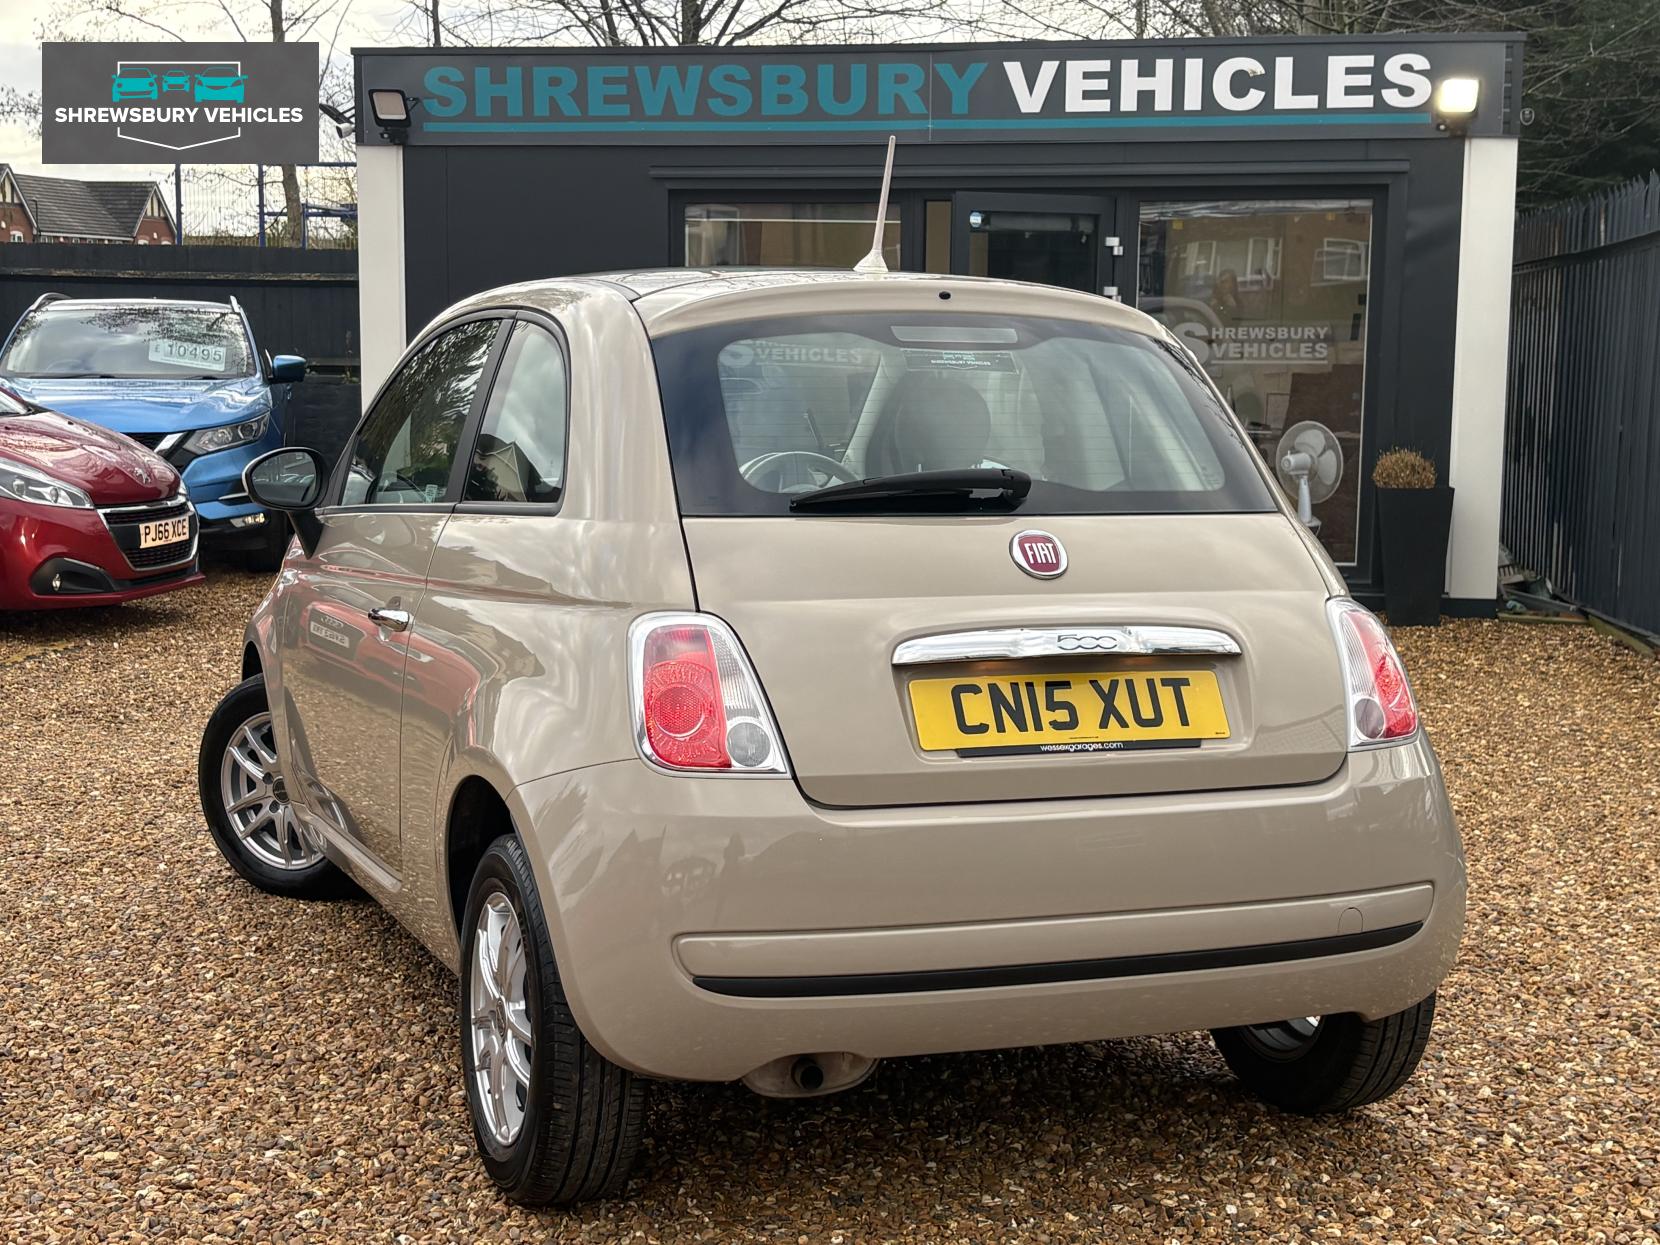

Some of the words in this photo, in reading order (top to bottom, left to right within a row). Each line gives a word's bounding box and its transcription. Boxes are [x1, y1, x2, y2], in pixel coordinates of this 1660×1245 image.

[423, 63, 987, 117] SHREWSBURY
[1003, 53, 1432, 113] VEHICLES
[168, 343, 222, 361] 10495
[756, 348, 862, 364] VEHICLES
[1212, 342, 1328, 358] VEHICLES
[144, 522, 169, 543] PJ66
[172, 518, 187, 538] XCE
[1024, 543, 1056, 564] FIAT
[1057, 634, 1117, 651] 500
[951, 680, 1080, 735] CN15
[1089, 678, 1190, 729] XUT
[1040, 742, 1124, 752] wessexgarages.com
